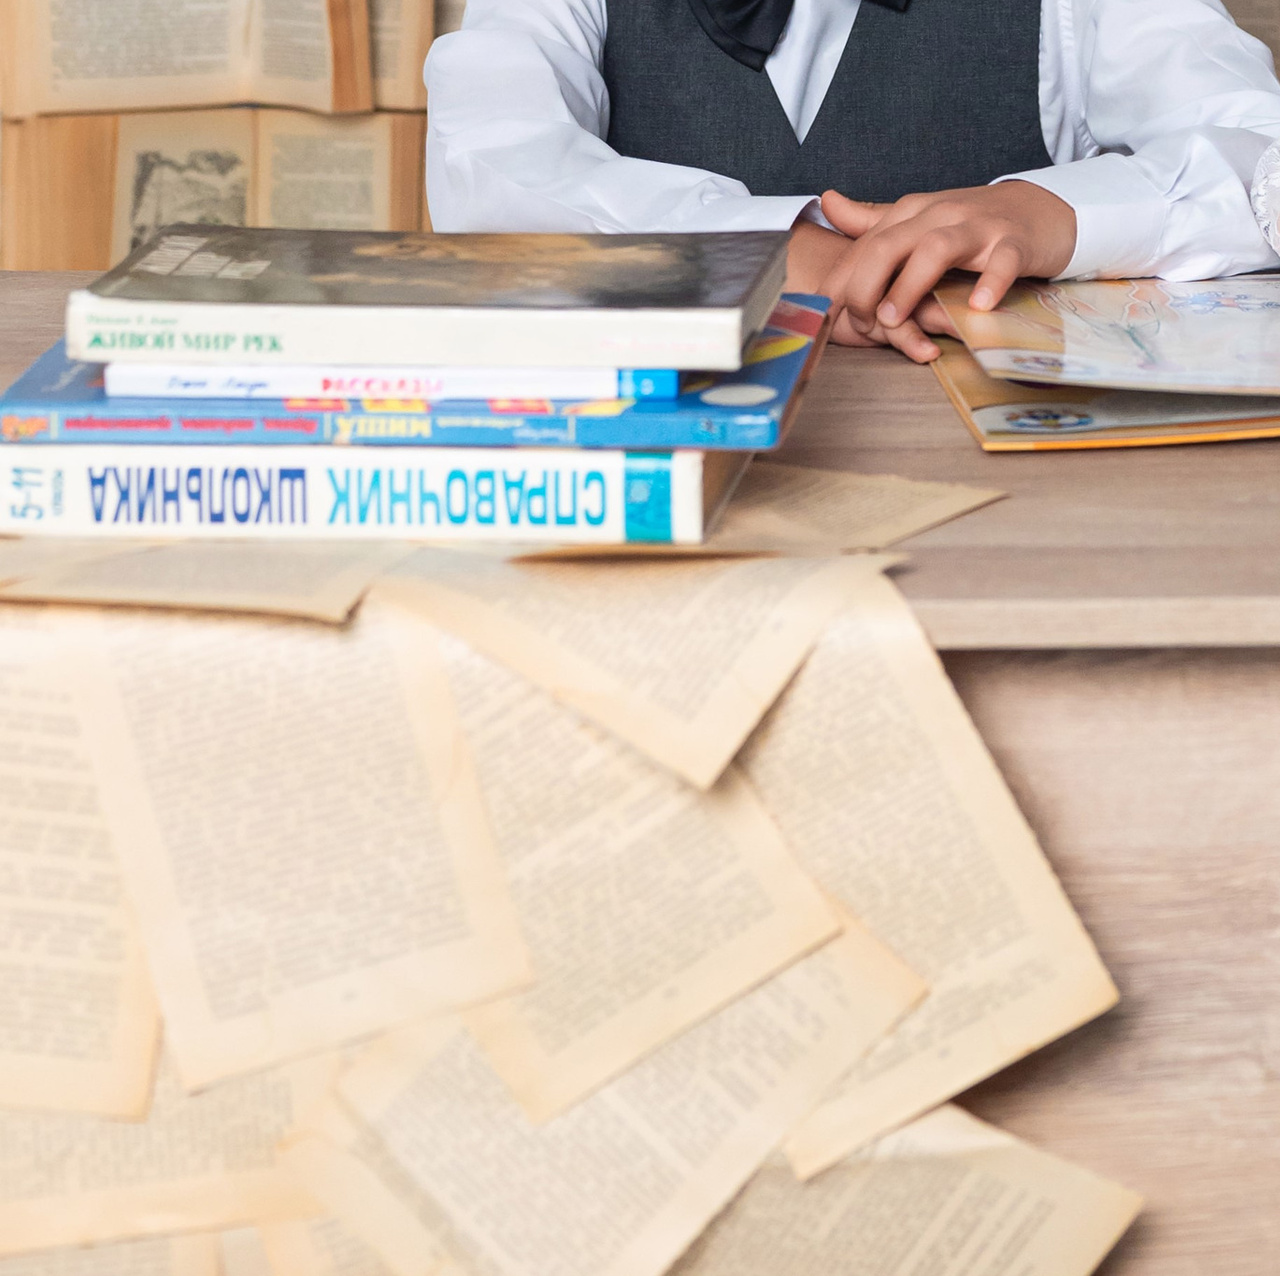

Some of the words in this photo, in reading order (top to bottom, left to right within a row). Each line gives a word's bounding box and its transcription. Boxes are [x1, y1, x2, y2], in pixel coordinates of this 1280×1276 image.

[87, 330, 175, 350] ЖИВОЙ
[182, 332, 237, 351] МИР
[242, 334, 284, 352] РЕК
[321, 377, 444, 394] РАССКАЗЫ
[88, 466, 307, 524] ШКОЛЬНИКА
[327, 468, 606, 525] СПРАВОЧНИК
